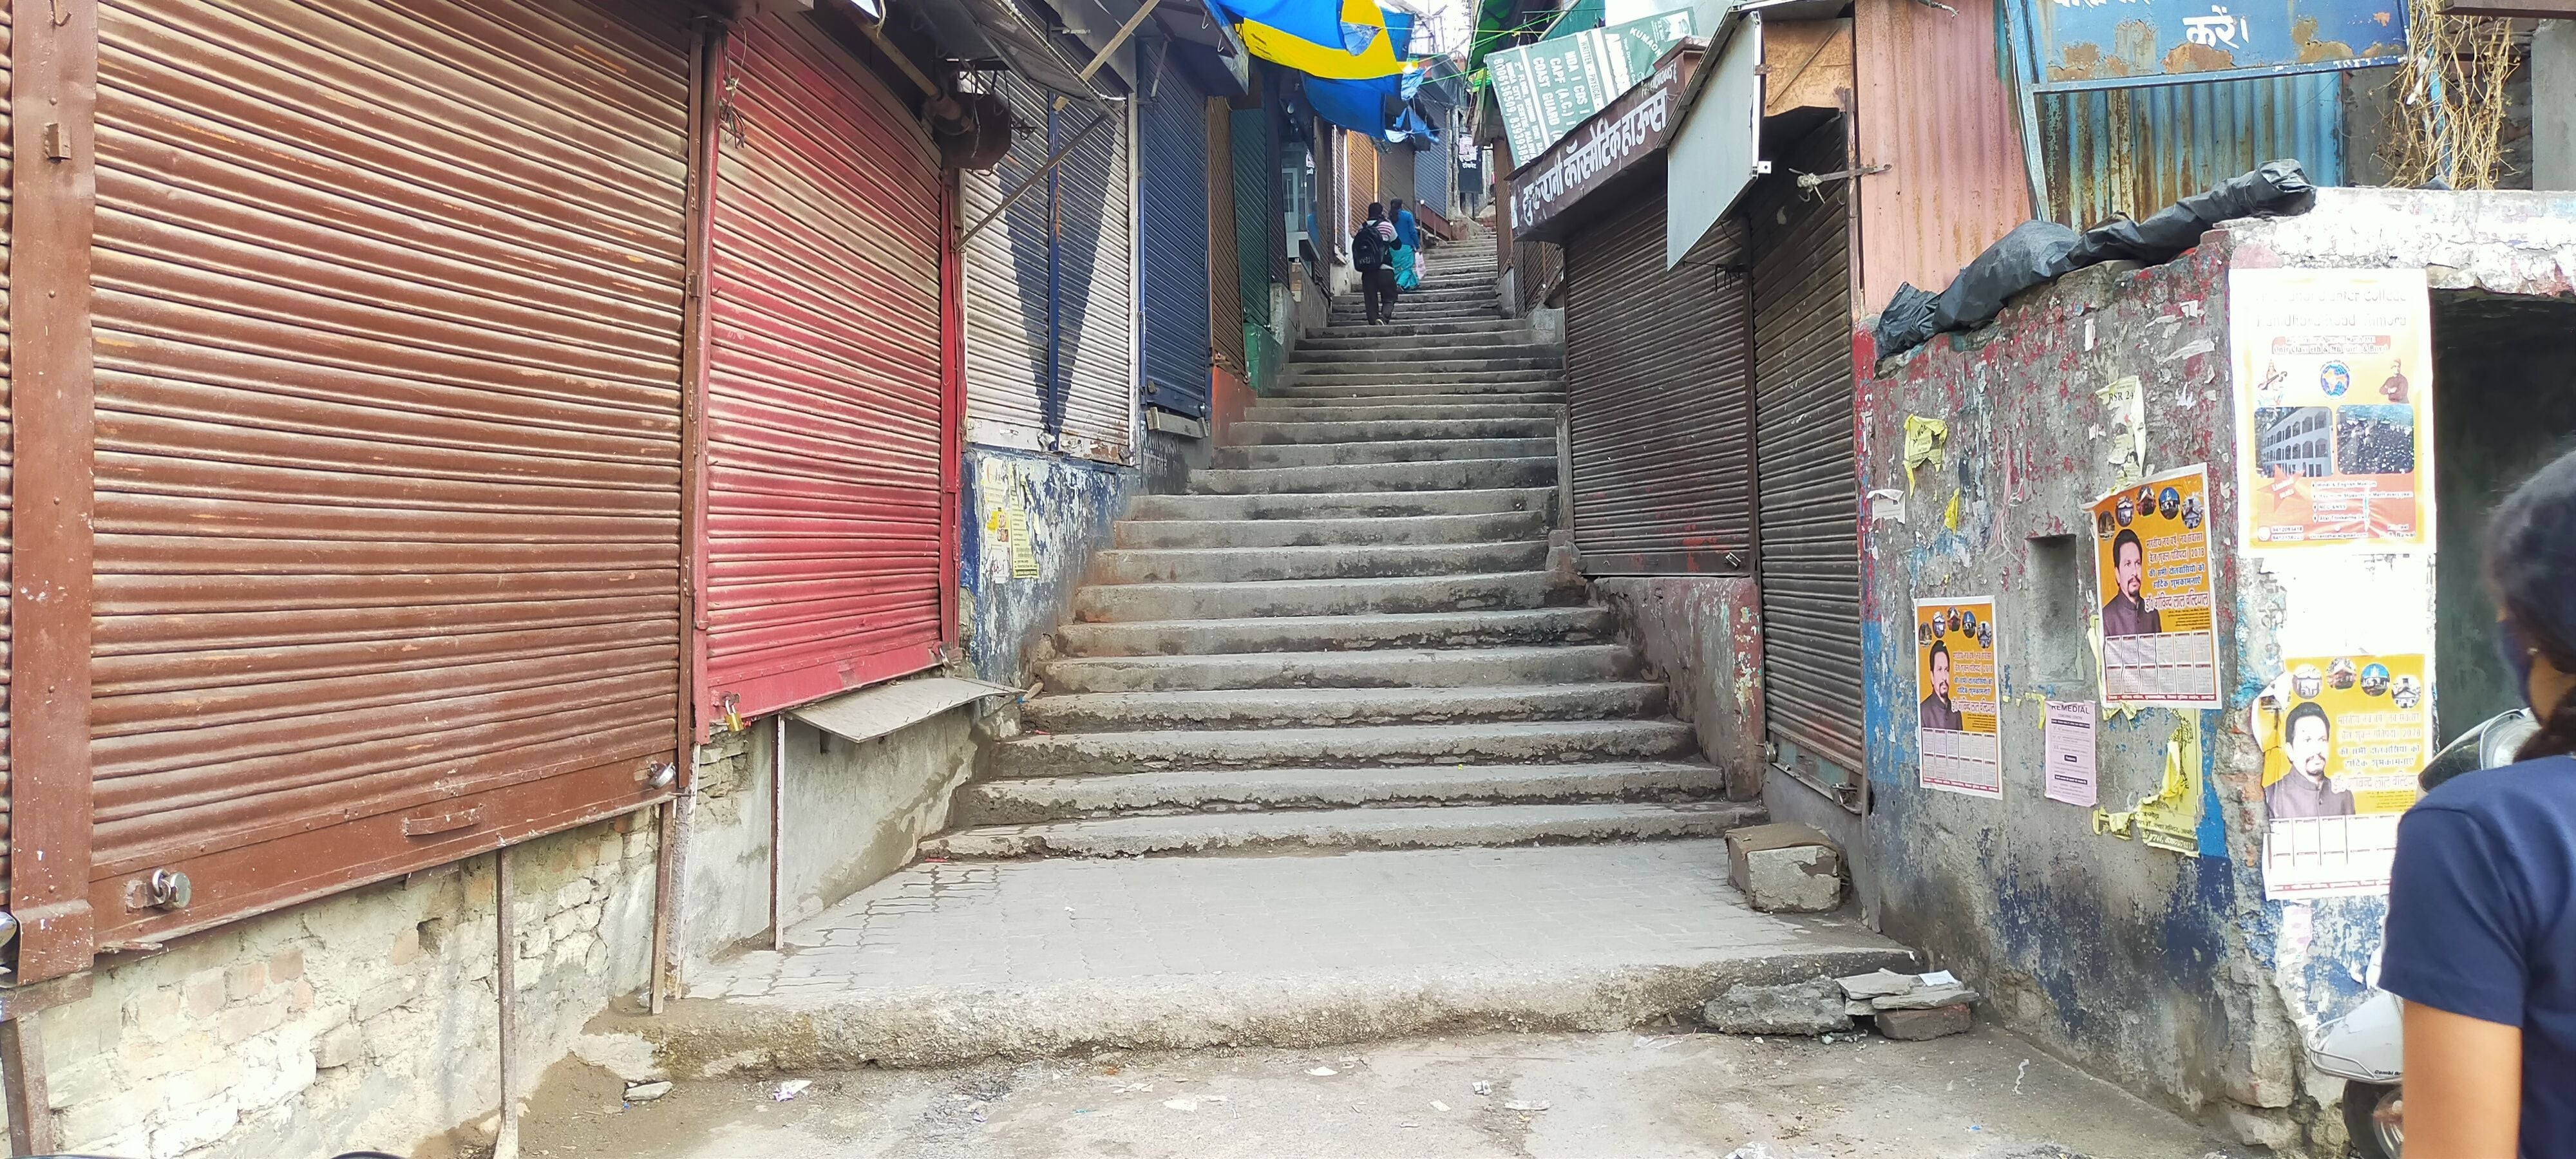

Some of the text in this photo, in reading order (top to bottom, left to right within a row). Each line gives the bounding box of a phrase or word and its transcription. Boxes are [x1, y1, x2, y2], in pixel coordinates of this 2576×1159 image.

[1629, 27, 1663, 57] KUMAON
[1549, 57, 1566, 84] CAPF
[1564, 51, 1587, 105] NDA CDS
[1581, 42, 1602, 100] WRITTEN PHYSICAL
[1512, 86, 1522, 100] CITY
[1533, 57, 1551, 87] COAST
[1542, 93, 1560, 126] GUARD
[2051, 704, 2090, 714] REMEDIAL
